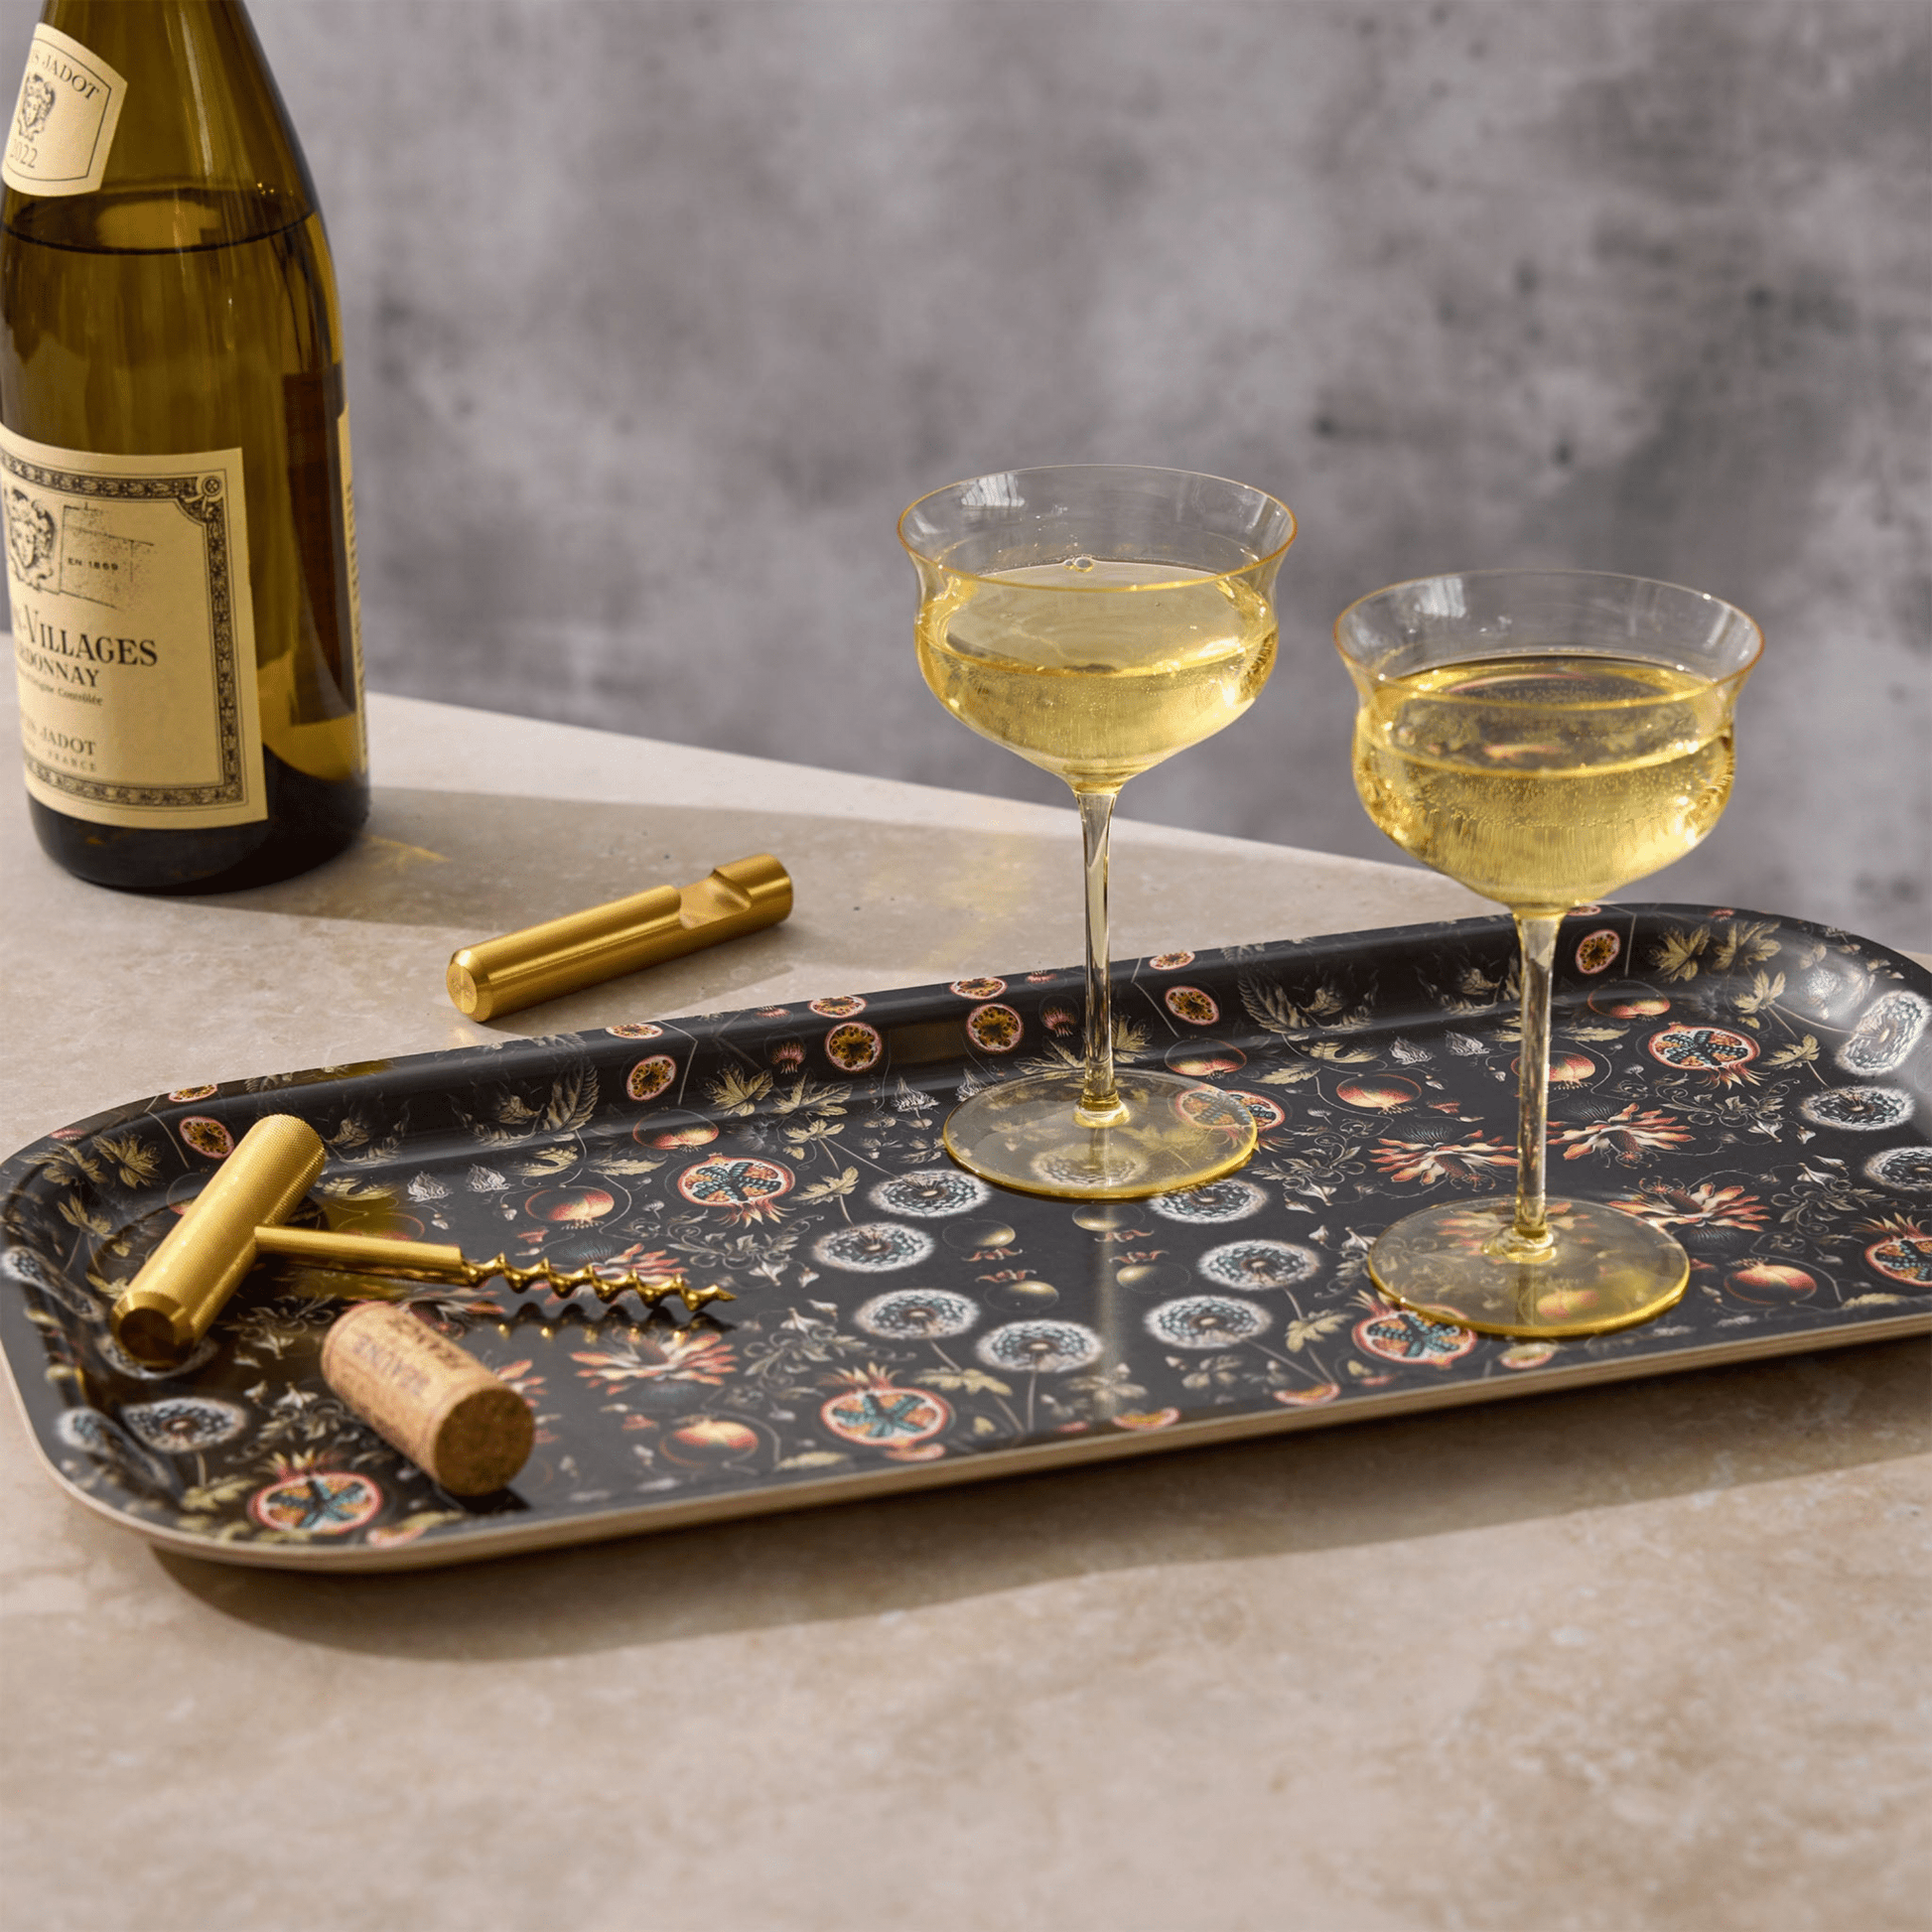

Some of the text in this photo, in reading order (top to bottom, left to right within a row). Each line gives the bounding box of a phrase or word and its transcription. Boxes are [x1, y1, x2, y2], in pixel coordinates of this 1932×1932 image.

[42, 55, 100, 100] JADOT
[67, 556, 83, 567] EN
[39, 726, 97, 756] JADOT
